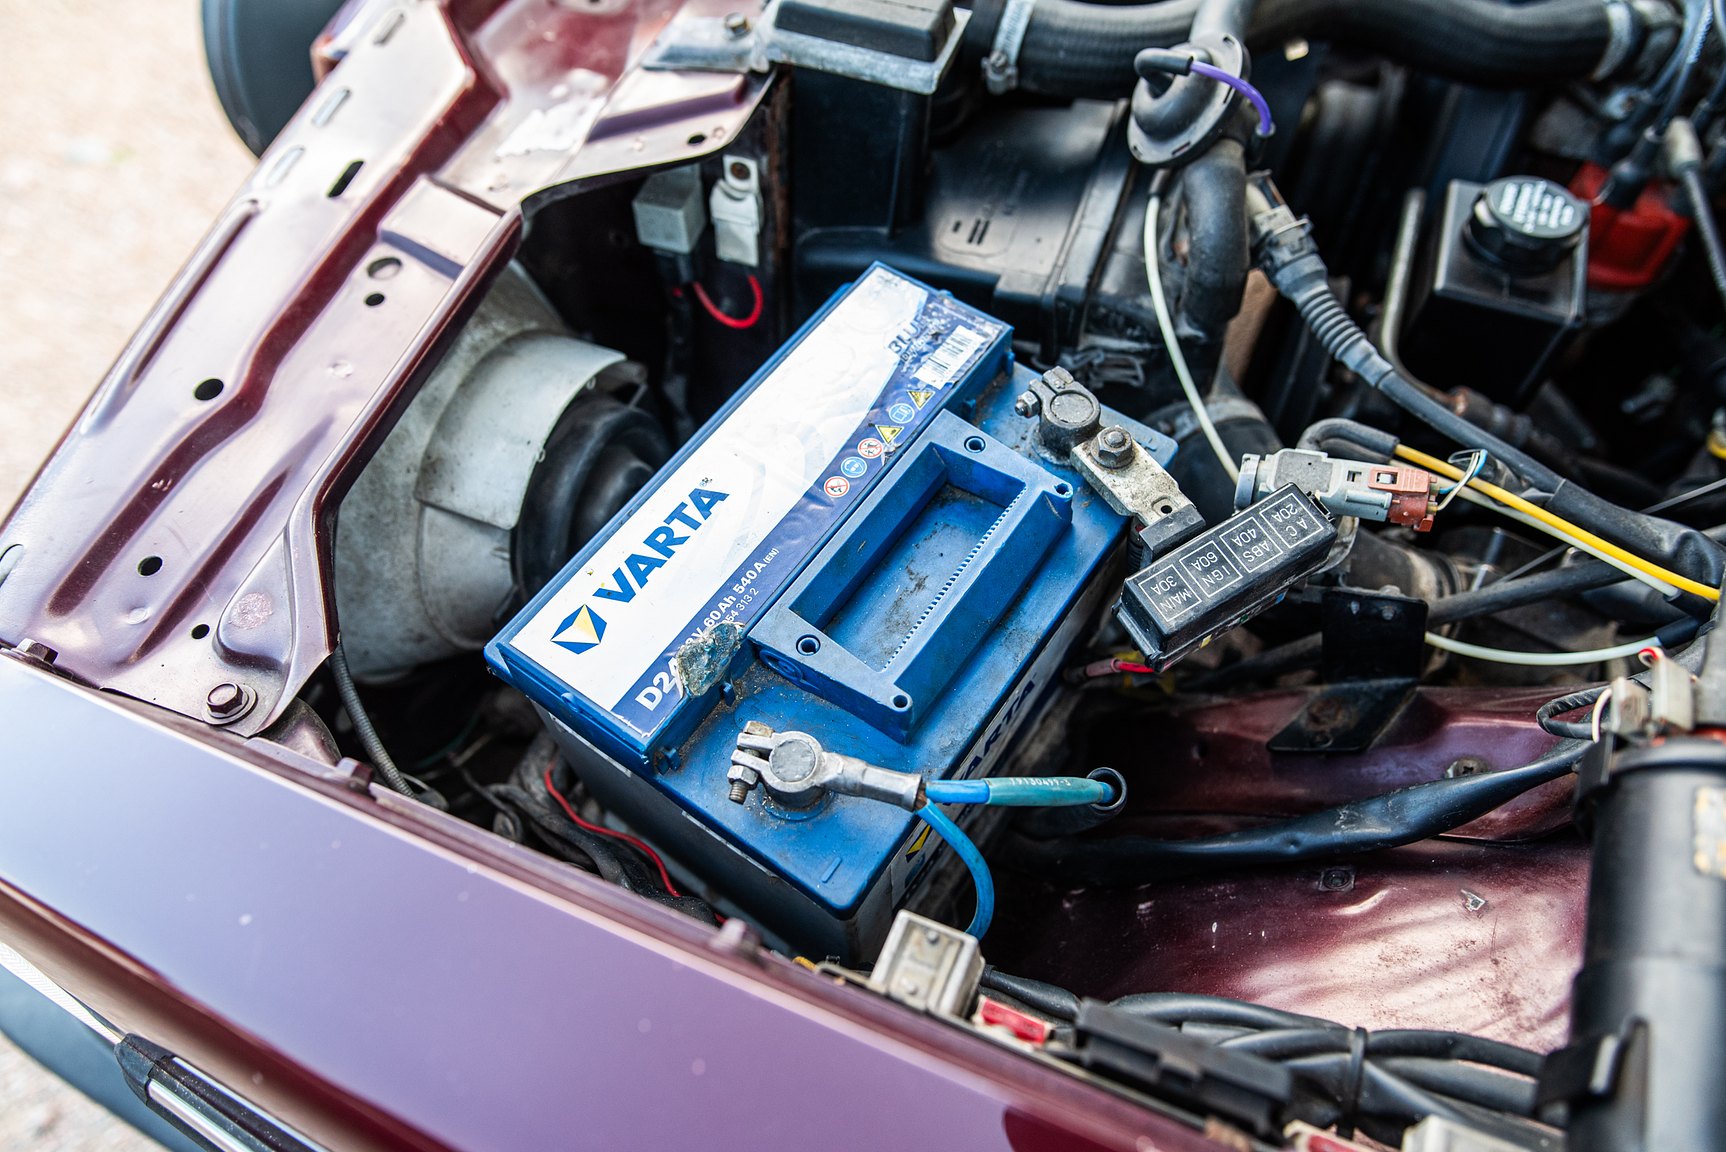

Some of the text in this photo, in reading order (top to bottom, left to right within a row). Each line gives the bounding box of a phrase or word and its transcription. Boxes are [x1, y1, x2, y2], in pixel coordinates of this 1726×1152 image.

[1271, 503, 1299, 523] 20A
[592, 487, 730, 603] VARTA
[1231, 527, 1257, 547] 40A
[1191, 551, 1219, 571] 60A
[1243, 540, 1271, 562] ABS
[1150, 575, 1178, 595] 30A
[1201, 565, 1231, 588] IGN
[736, 594, 753, 611] 313
[749, 587, 760, 597] 2
[1159, 587, 1193, 608] MAIN
[704, 594, 737, 628] 60Ah
[950, 680, 1036, 798] ARTA
